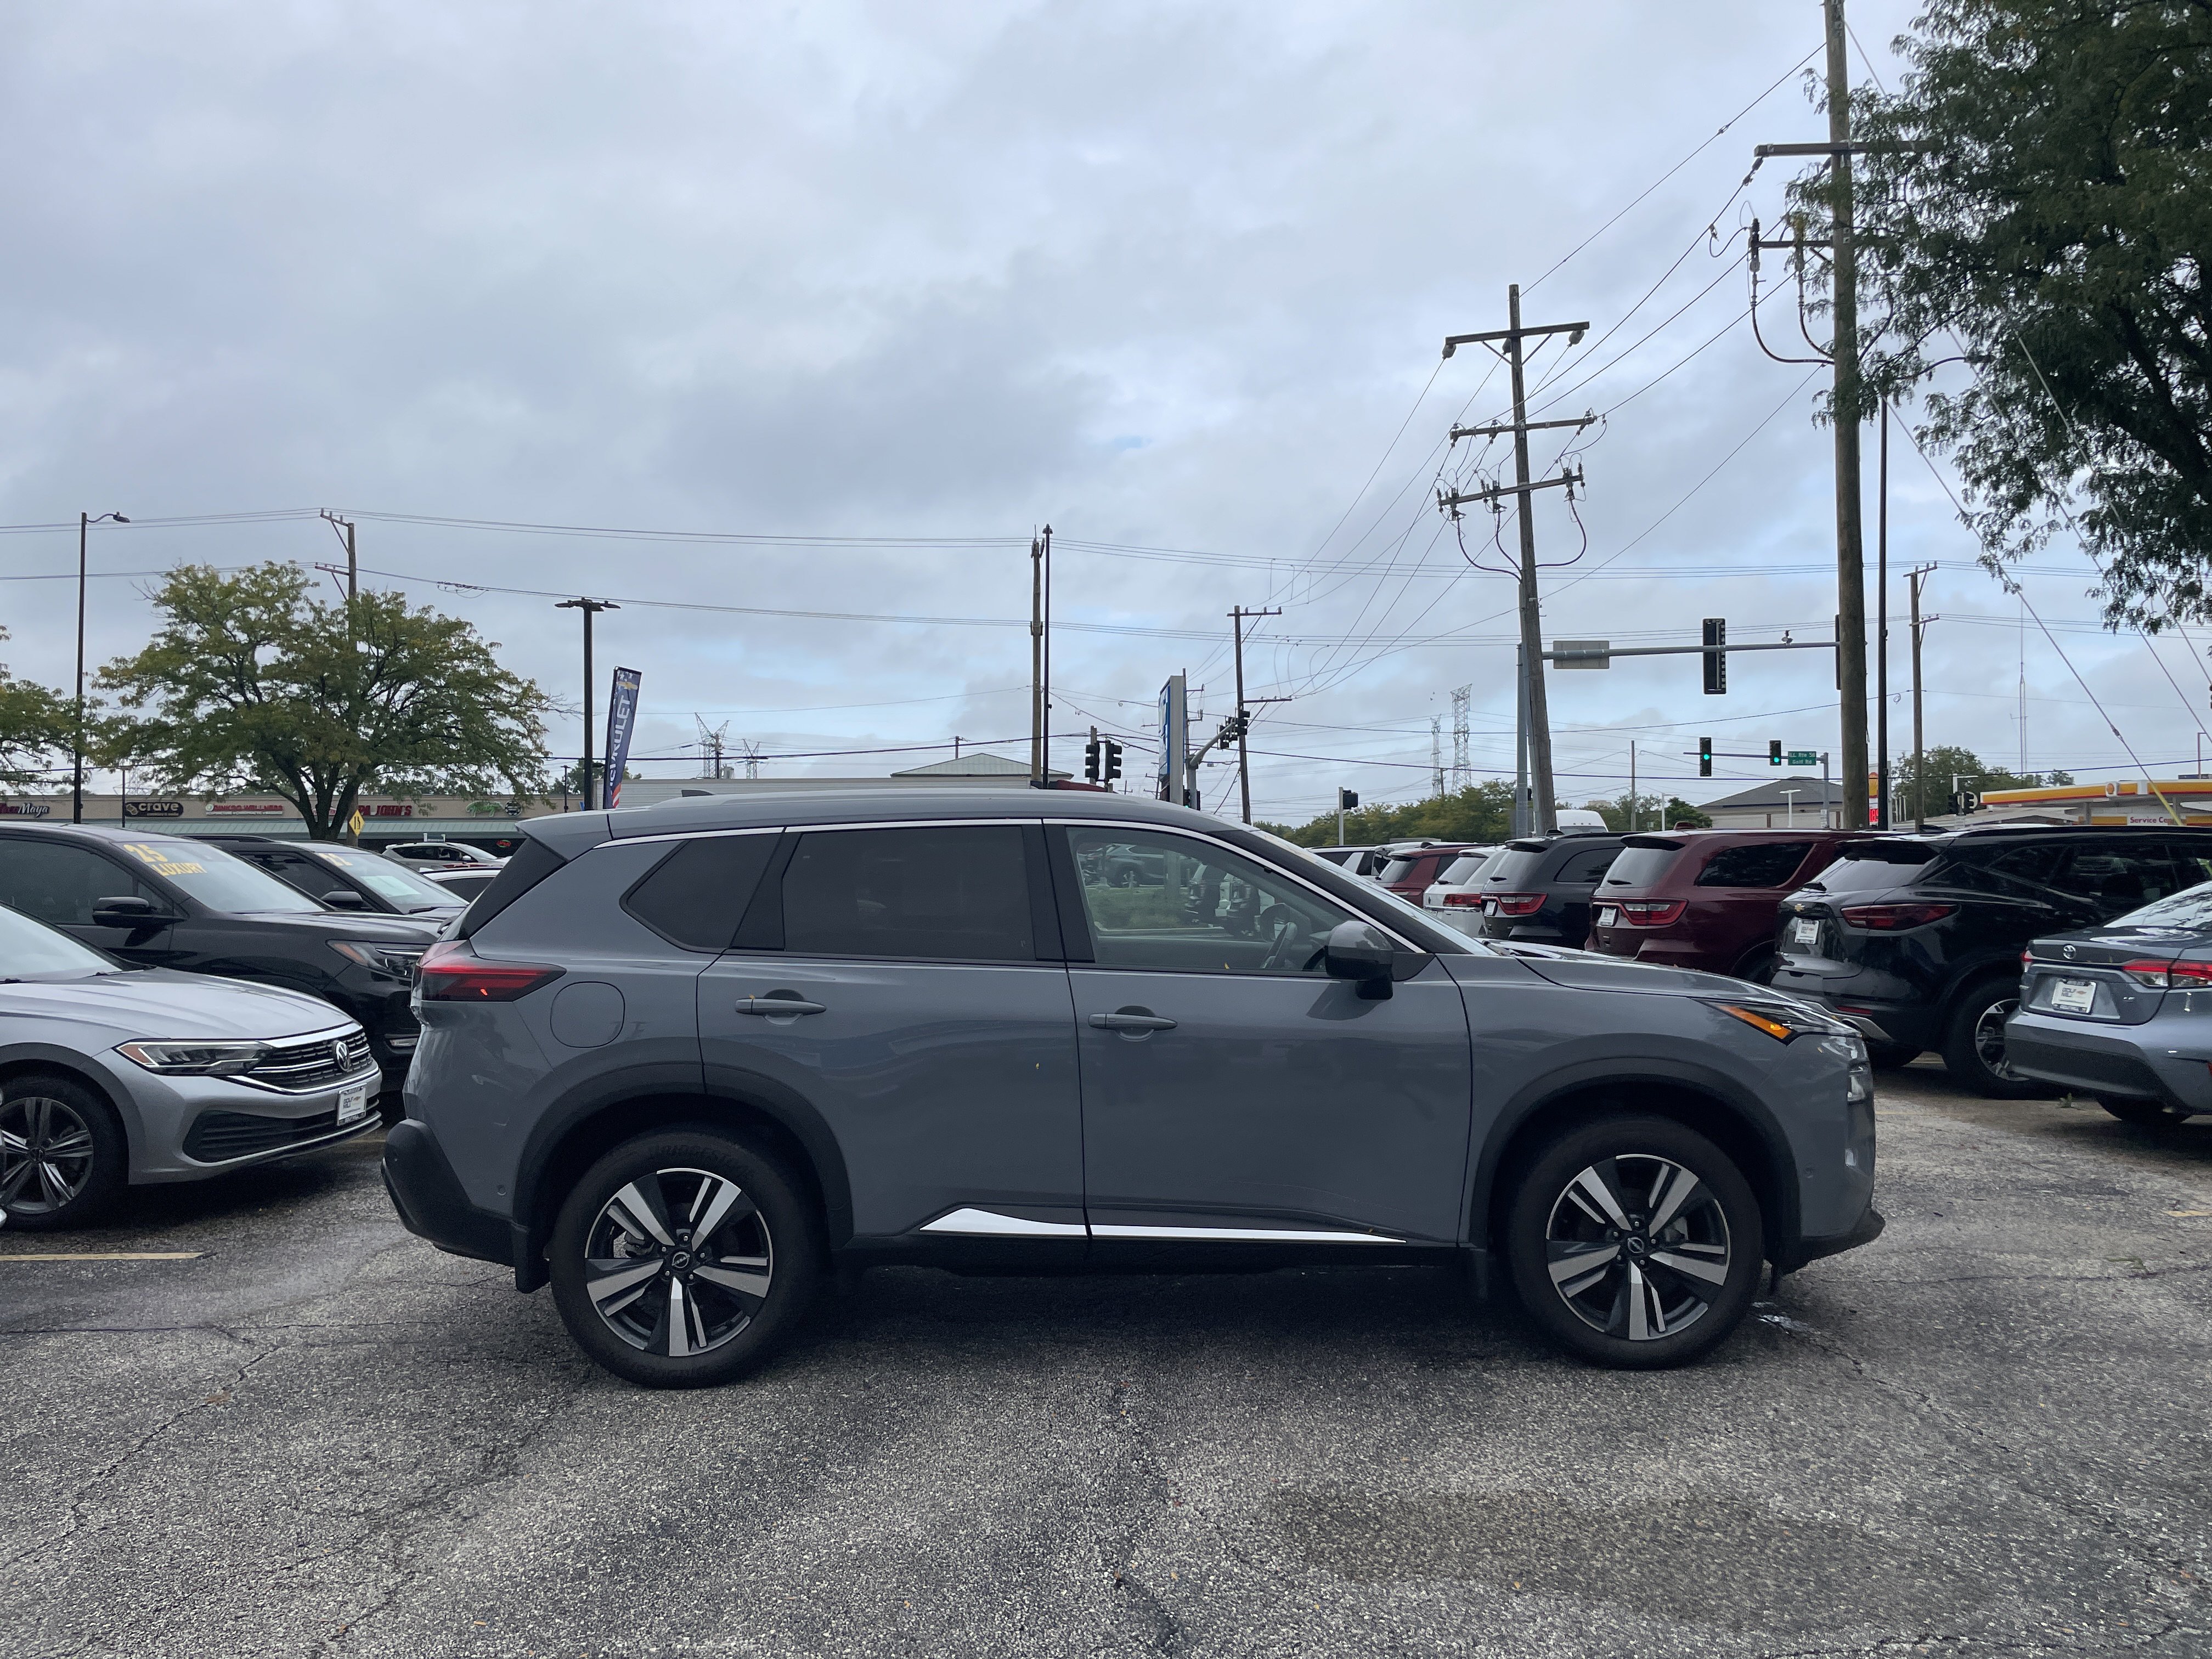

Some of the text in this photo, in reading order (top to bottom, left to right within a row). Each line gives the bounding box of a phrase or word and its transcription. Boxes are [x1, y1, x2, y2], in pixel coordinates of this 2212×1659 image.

[18, 802, 49, 818] Maya
[138, 803, 179, 811] crave
[375, 805, 412, 816] JOHN'S
[123, 845, 168, 862] 25
[151, 862, 207, 876] LUXURY
